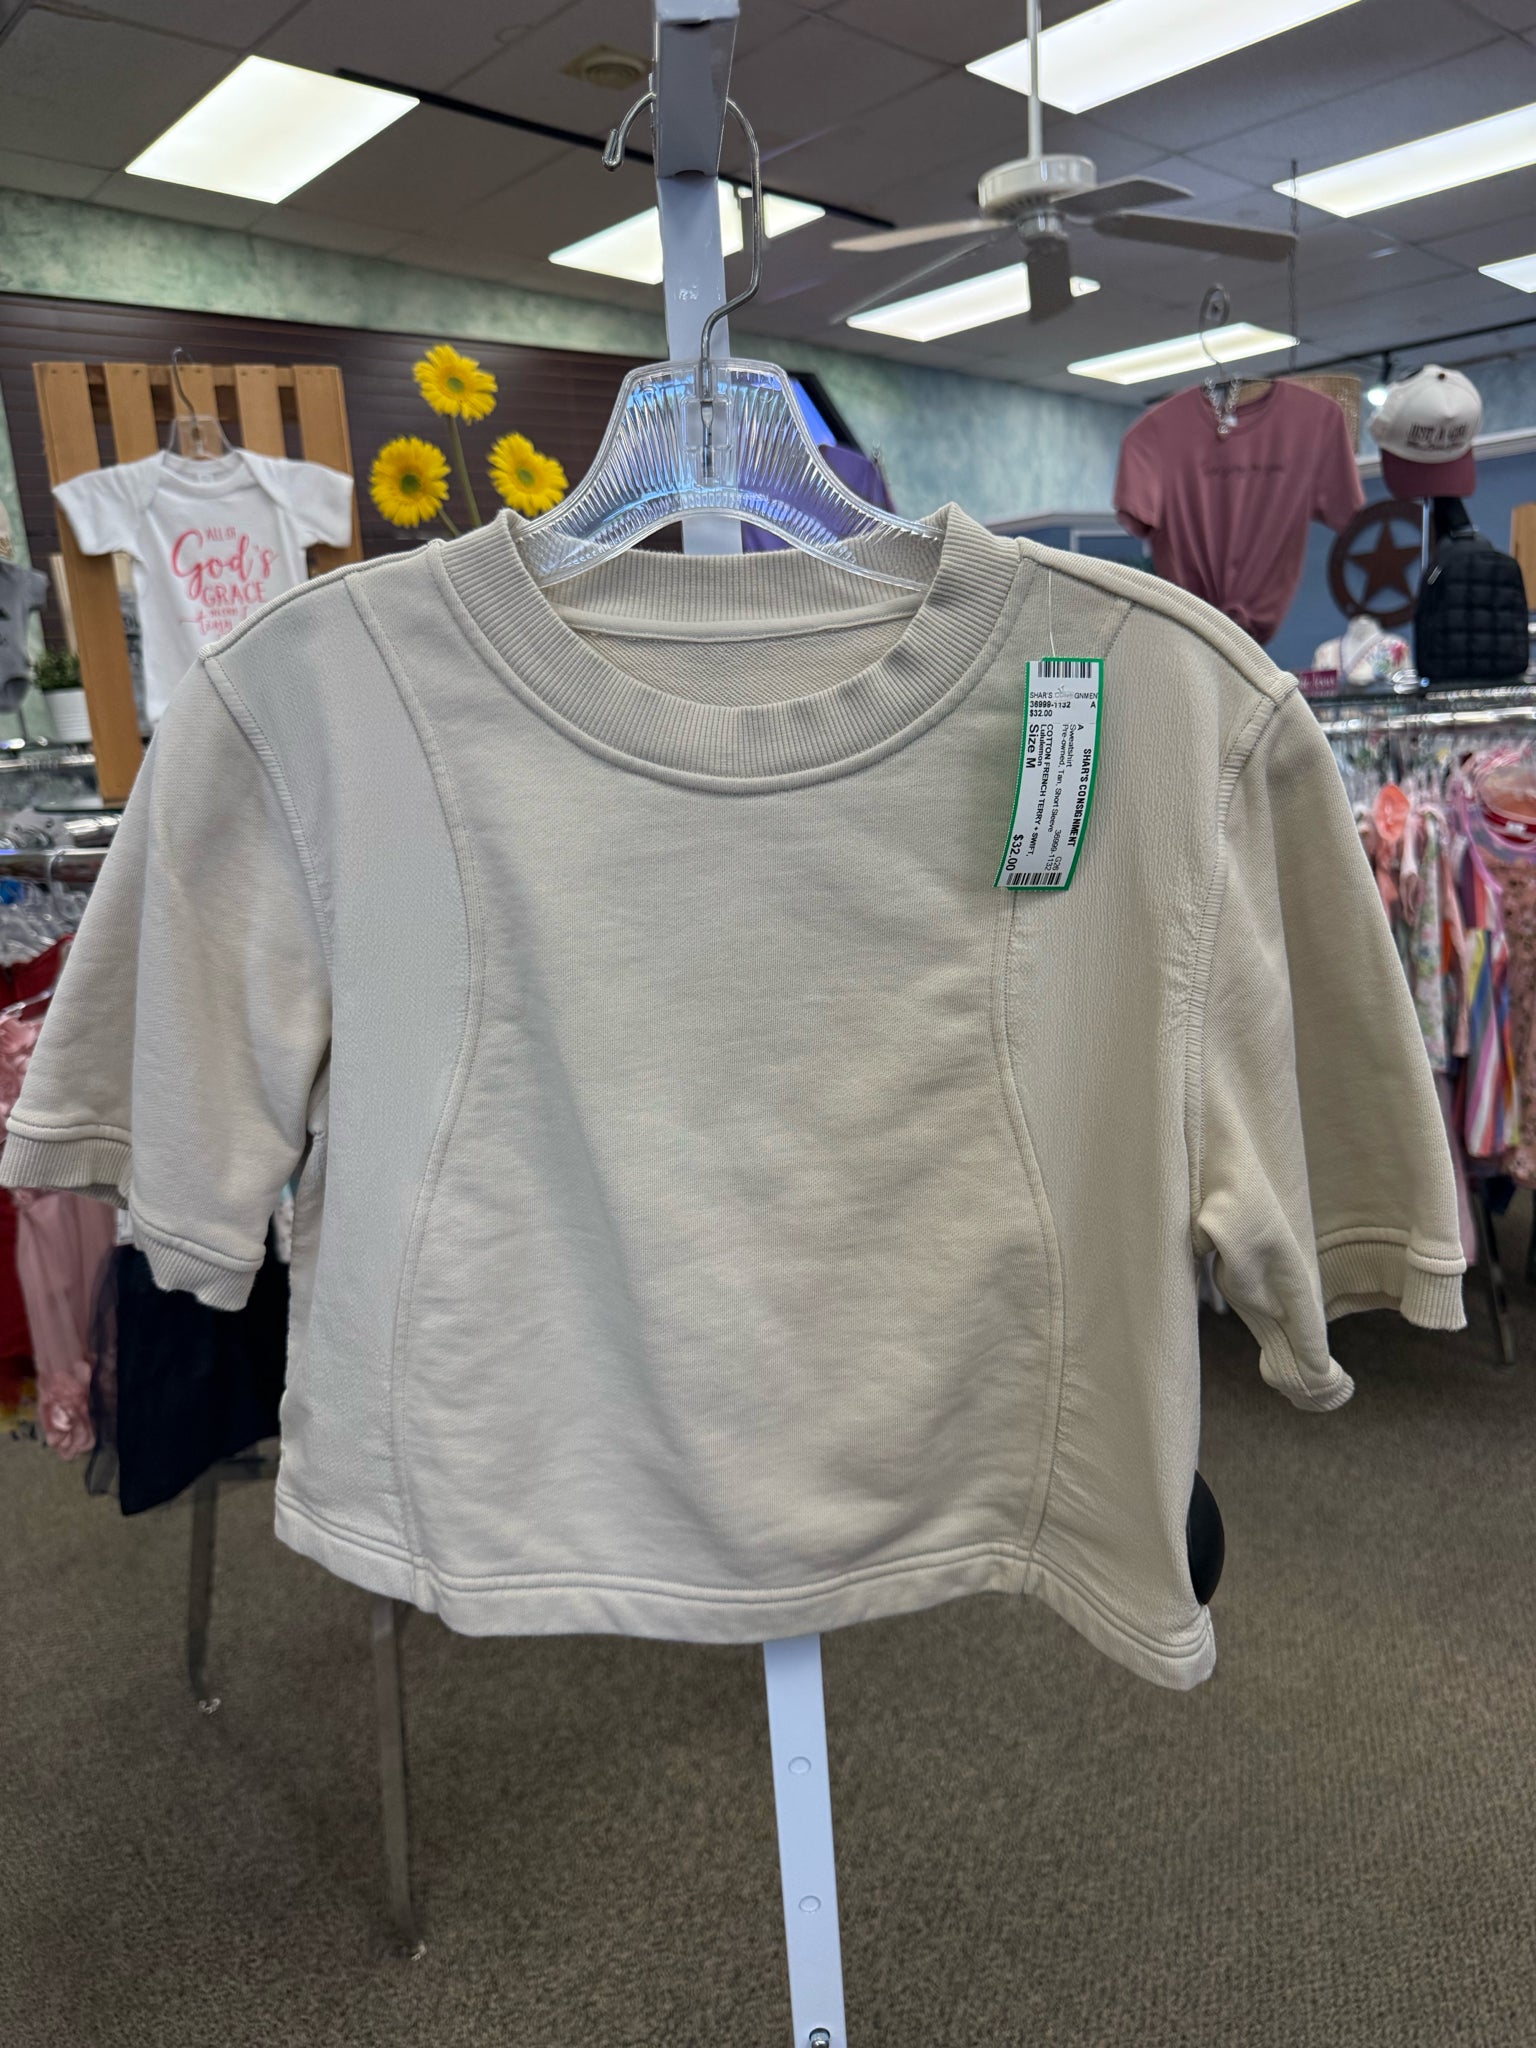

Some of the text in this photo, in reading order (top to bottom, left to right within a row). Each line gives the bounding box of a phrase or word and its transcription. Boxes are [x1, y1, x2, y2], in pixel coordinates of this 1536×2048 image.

[206, 527, 224, 541] ALL
[172, 527, 278, 600] God's
[202, 580, 266, 607] GRACE
[1029, 691, 1053, 699] SHAR'S
[1029, 709, 1053, 717] $32.00
[1025, 724, 1040, 768] Size M
[1037, 724, 1047, 766] Lululemon
[1044, 724, 1054, 760] COTTON
[1058, 724, 1069, 768] Pre-owned,
[1066, 724, 1077, 767] Sweatshirt
[1039, 761, 1050, 797] FRENCH
[1052, 787, 1062, 807] Short
[1034, 798, 1045, 825] TERRY
[1067, 748, 1092, 847] SHAR'S CONSIGNMENT
[1048, 808, 1059, 833] Sleeve
[1005, 834, 1024, 871] $32.00
